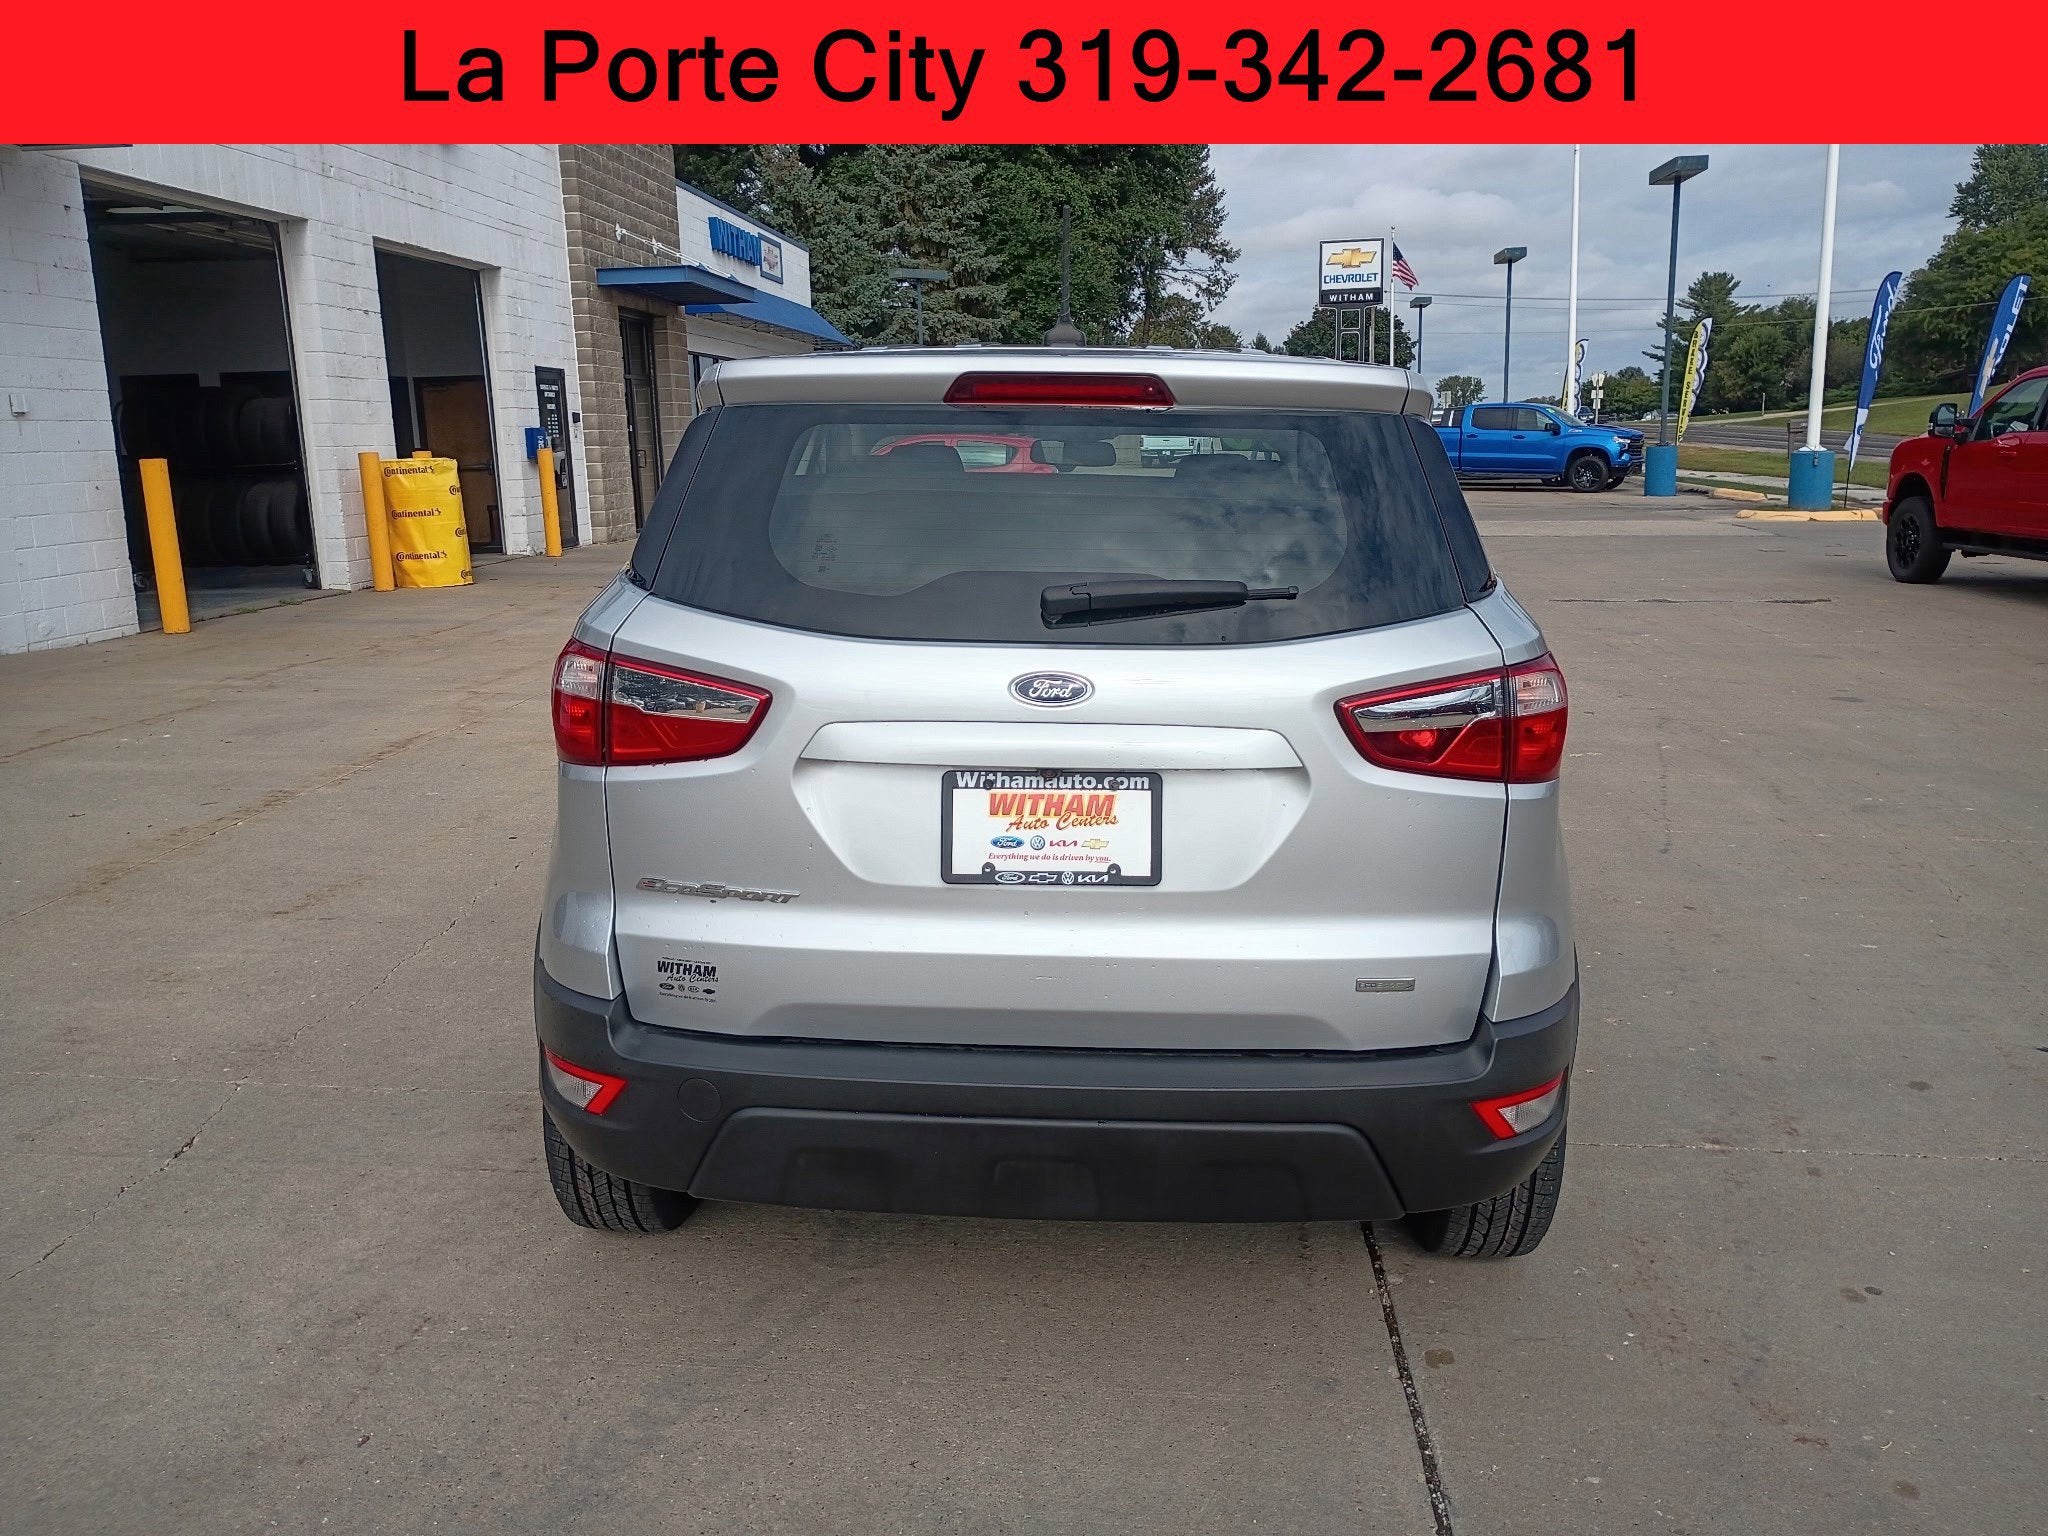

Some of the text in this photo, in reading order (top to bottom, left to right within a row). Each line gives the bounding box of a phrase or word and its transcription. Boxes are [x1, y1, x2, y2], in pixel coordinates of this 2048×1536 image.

[1323, 272, 1379, 284] CHEVROLET
[1329, 293, 1374, 302] WITHAM
[1688, 331, 1699, 375] BRAKE
[384, 466, 428, 478] Continental
[391, 509, 434, 520] Continental
[396, 551, 440, 562] Continental
[1028, 679, 1080, 698] Ford
[956, 771, 1149, 790] Withamauto.com
[988, 793, 1117, 817] WITHAM
[1006, 812, 1119, 832] Auto Centers
[988, 852, 1029, 862] Everything
[1041, 853, 1051, 861] do
[1052, 853, 1059, 861] is
[1059, 853, 1084, 861] driven
[1085, 854, 1095, 863] by
[657, 960, 717, 978] WITHAM
[665, 972, 719, 983] Auto Centers
